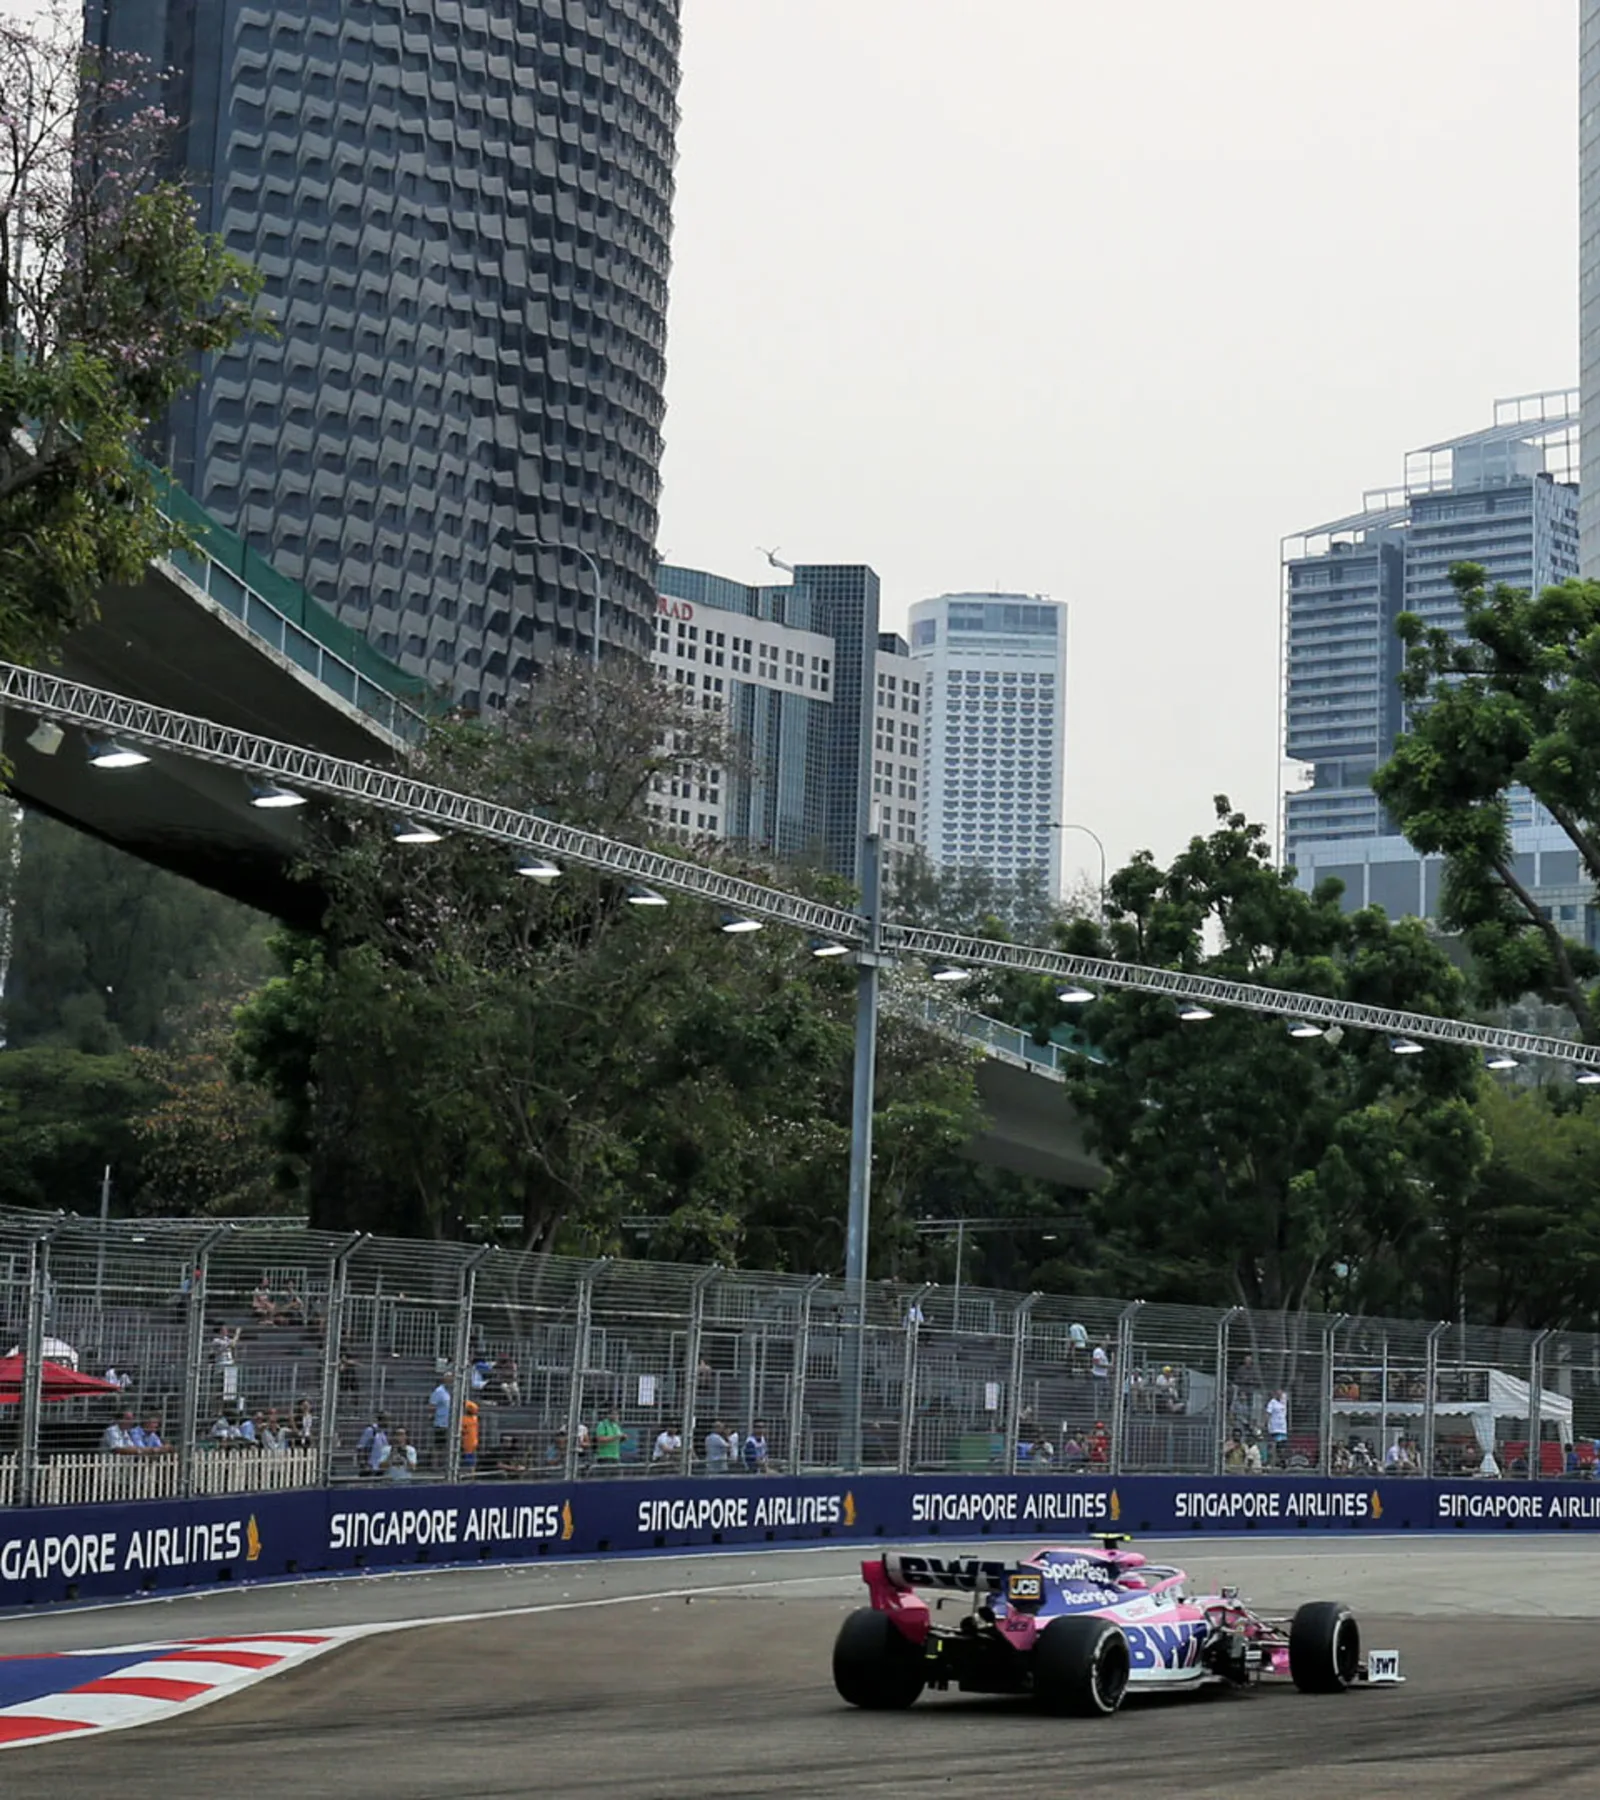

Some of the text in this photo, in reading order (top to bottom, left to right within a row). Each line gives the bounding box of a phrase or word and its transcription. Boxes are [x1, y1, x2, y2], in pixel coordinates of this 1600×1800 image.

[639, 1496, 842, 1532] SINGAPORE AIRLINES
[913, 1493, 1108, 1521] SINGAPORE AIRLINES
[1176, 1493, 1368, 1517] SINGAPORE AIRLINES
[1440, 1494, 1543, 1518] SINGAPORE
[330, 1506, 559, 1549] SINGAPORE AIRLINES
[1, 1521, 241, 1580] GAPORE AIRLINES
[900, 1556, 1004, 1591] BWT
[1011, 1579, 1040, 1596] JCB
[1062, 1589, 1107, 1606] Racing
[1125, 1623, 1208, 1669] BWT
[1375, 1657, 1397, 1675] BWT
